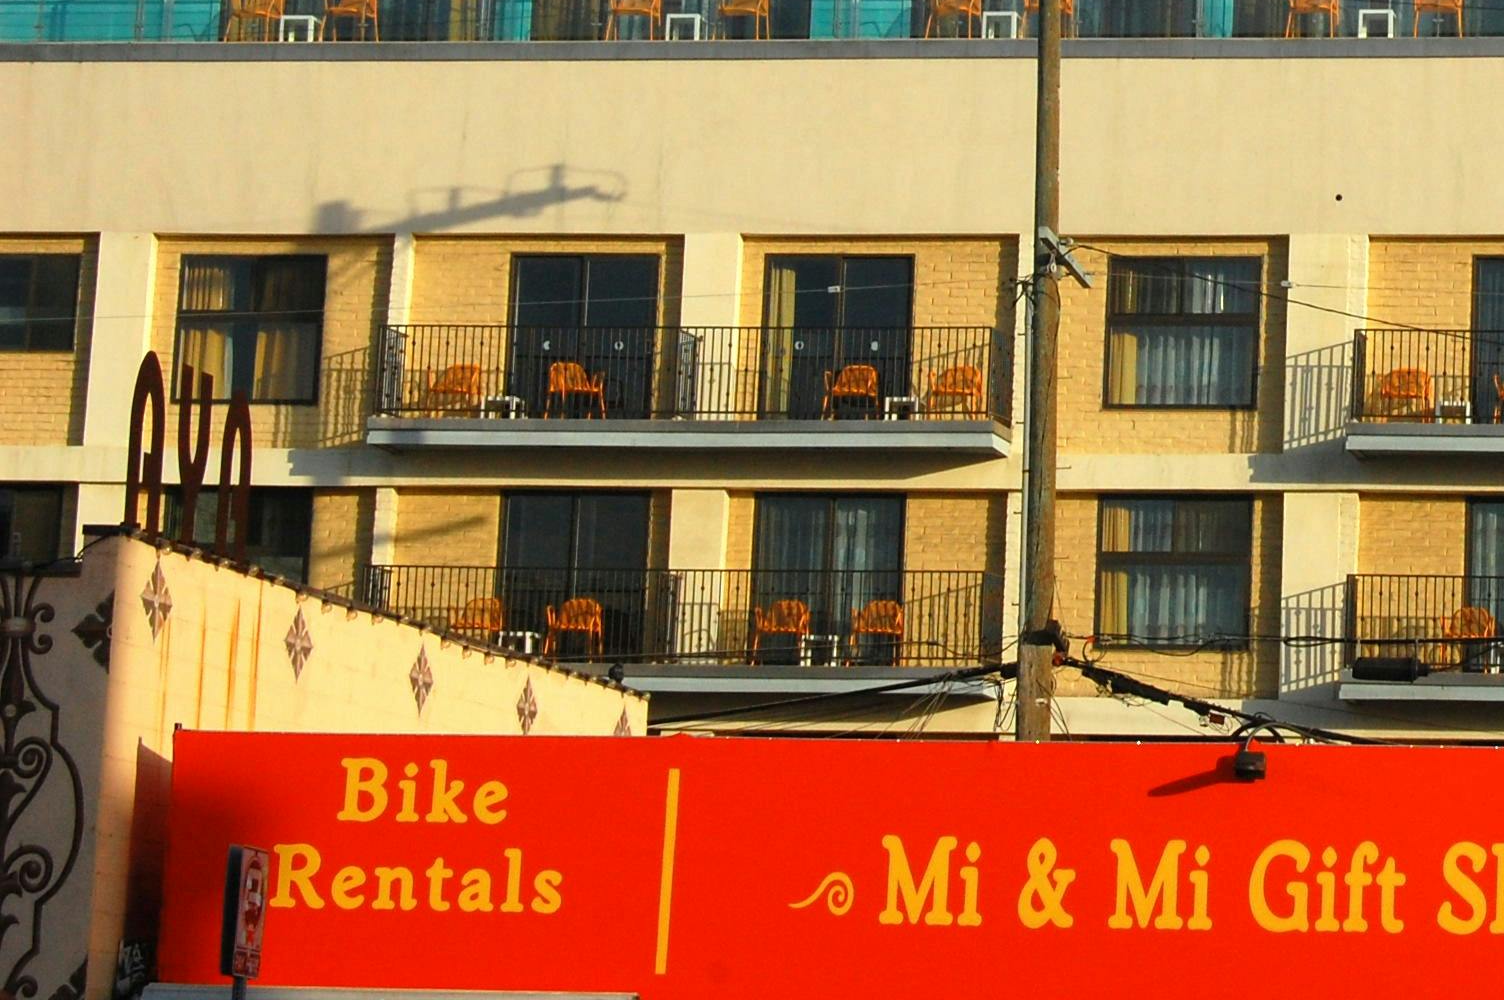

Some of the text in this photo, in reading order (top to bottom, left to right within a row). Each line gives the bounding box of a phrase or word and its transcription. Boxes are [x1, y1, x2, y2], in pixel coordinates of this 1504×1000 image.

[336, 757, 510, 825] Bike
[269, 843, 564, 914] Rentals
[878, 834, 983, 927] Mi
[1017, 837, 1076, 929] &
[1107, 838, 1213, 931] Mi
[1248, 839, 1407, 934] Gift
